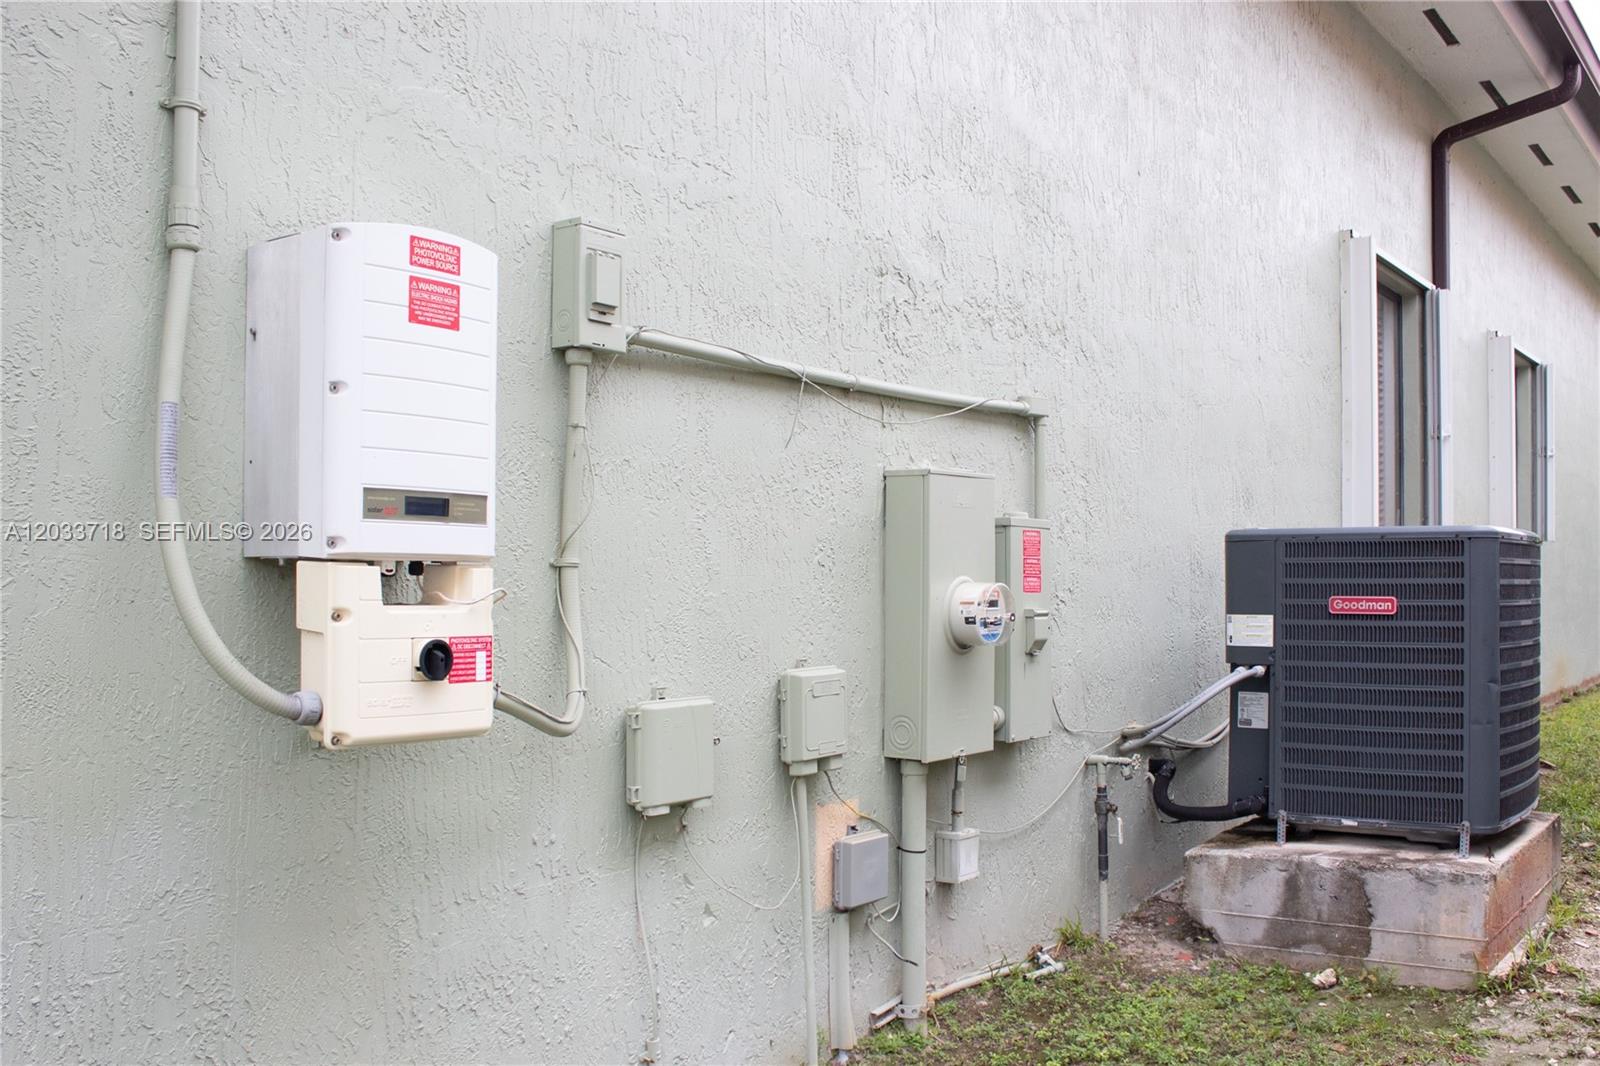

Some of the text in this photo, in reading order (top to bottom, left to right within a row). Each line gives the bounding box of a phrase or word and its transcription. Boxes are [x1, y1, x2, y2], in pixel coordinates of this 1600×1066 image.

[419, 239, 453, 253] WARNING
[414, 247, 458, 264] PHOTOVOLTAIC
[412, 255, 459, 273] POWER SOURCE
[418, 281, 452, 296] WARNING
[1333, 599, 1392, 610] Goodman
